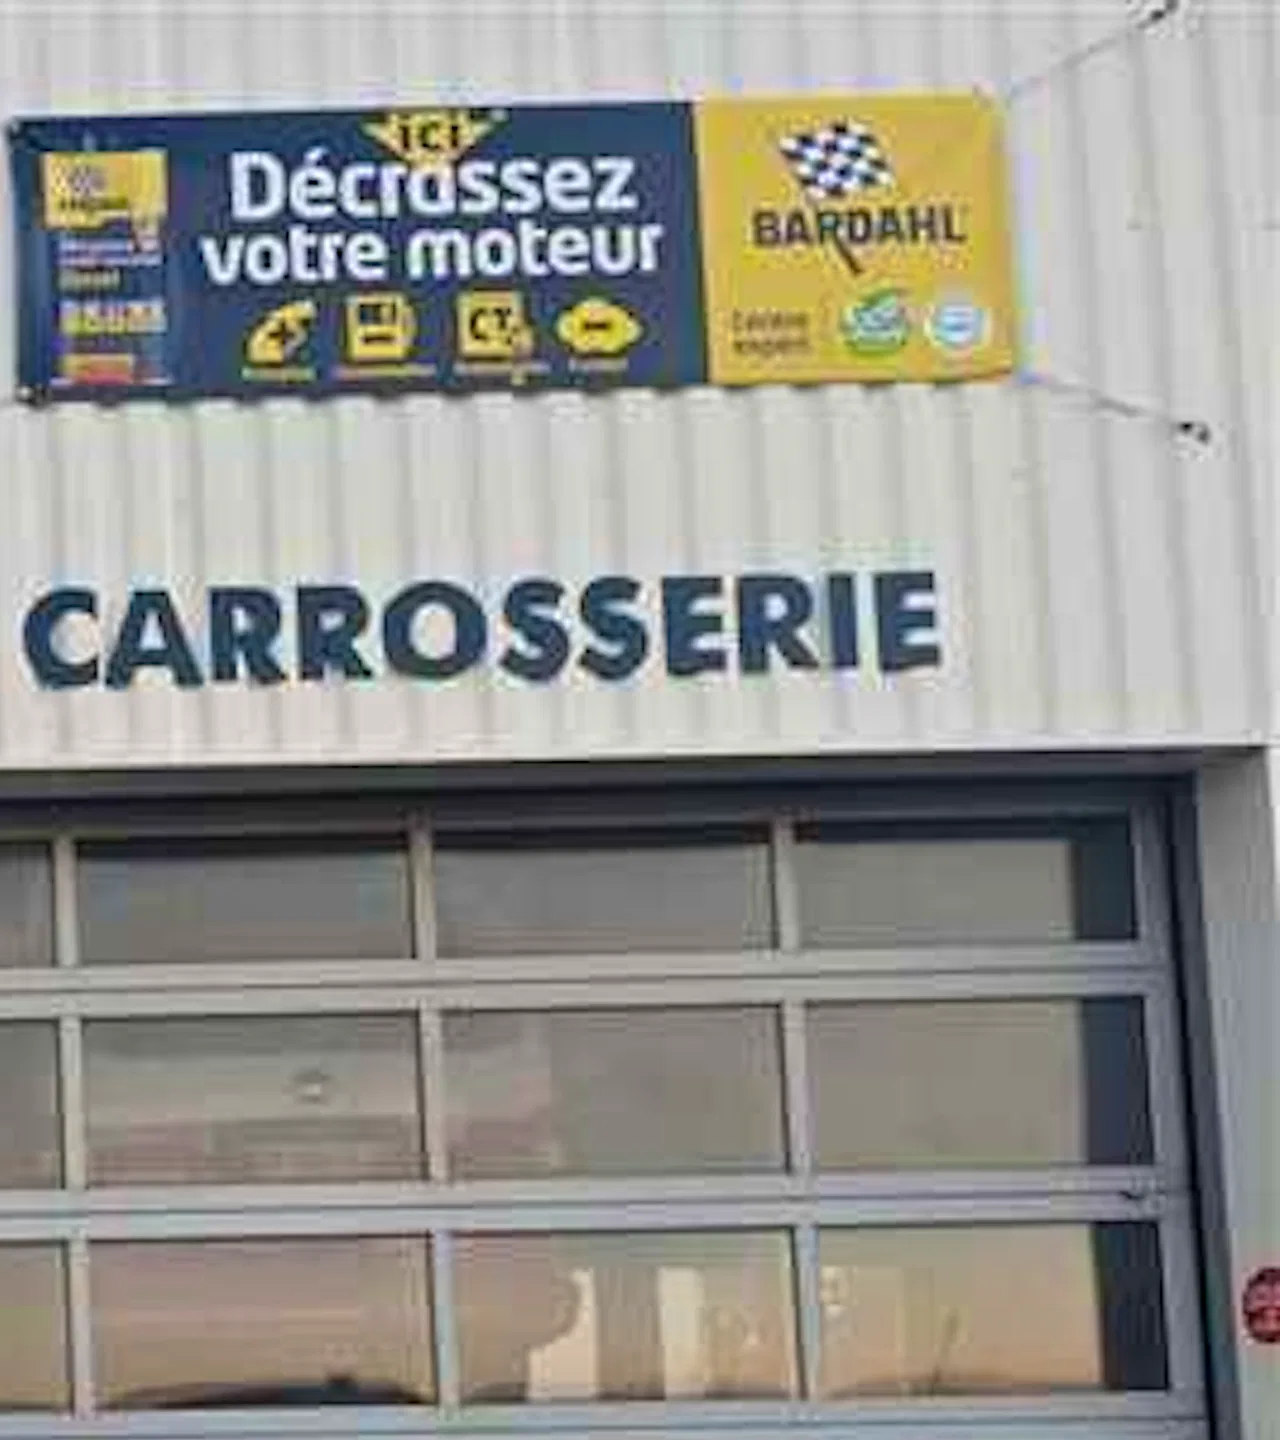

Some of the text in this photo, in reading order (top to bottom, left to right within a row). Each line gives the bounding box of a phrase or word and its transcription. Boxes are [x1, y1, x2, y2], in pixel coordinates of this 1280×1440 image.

[228, 146, 639, 220] Décrassez
[200, 224, 386, 285] votre
[407, 219, 664, 278] moteur
[751, 204, 967, 275] BARDAHL
[21, 570, 942, 689] CARROSSERIE
